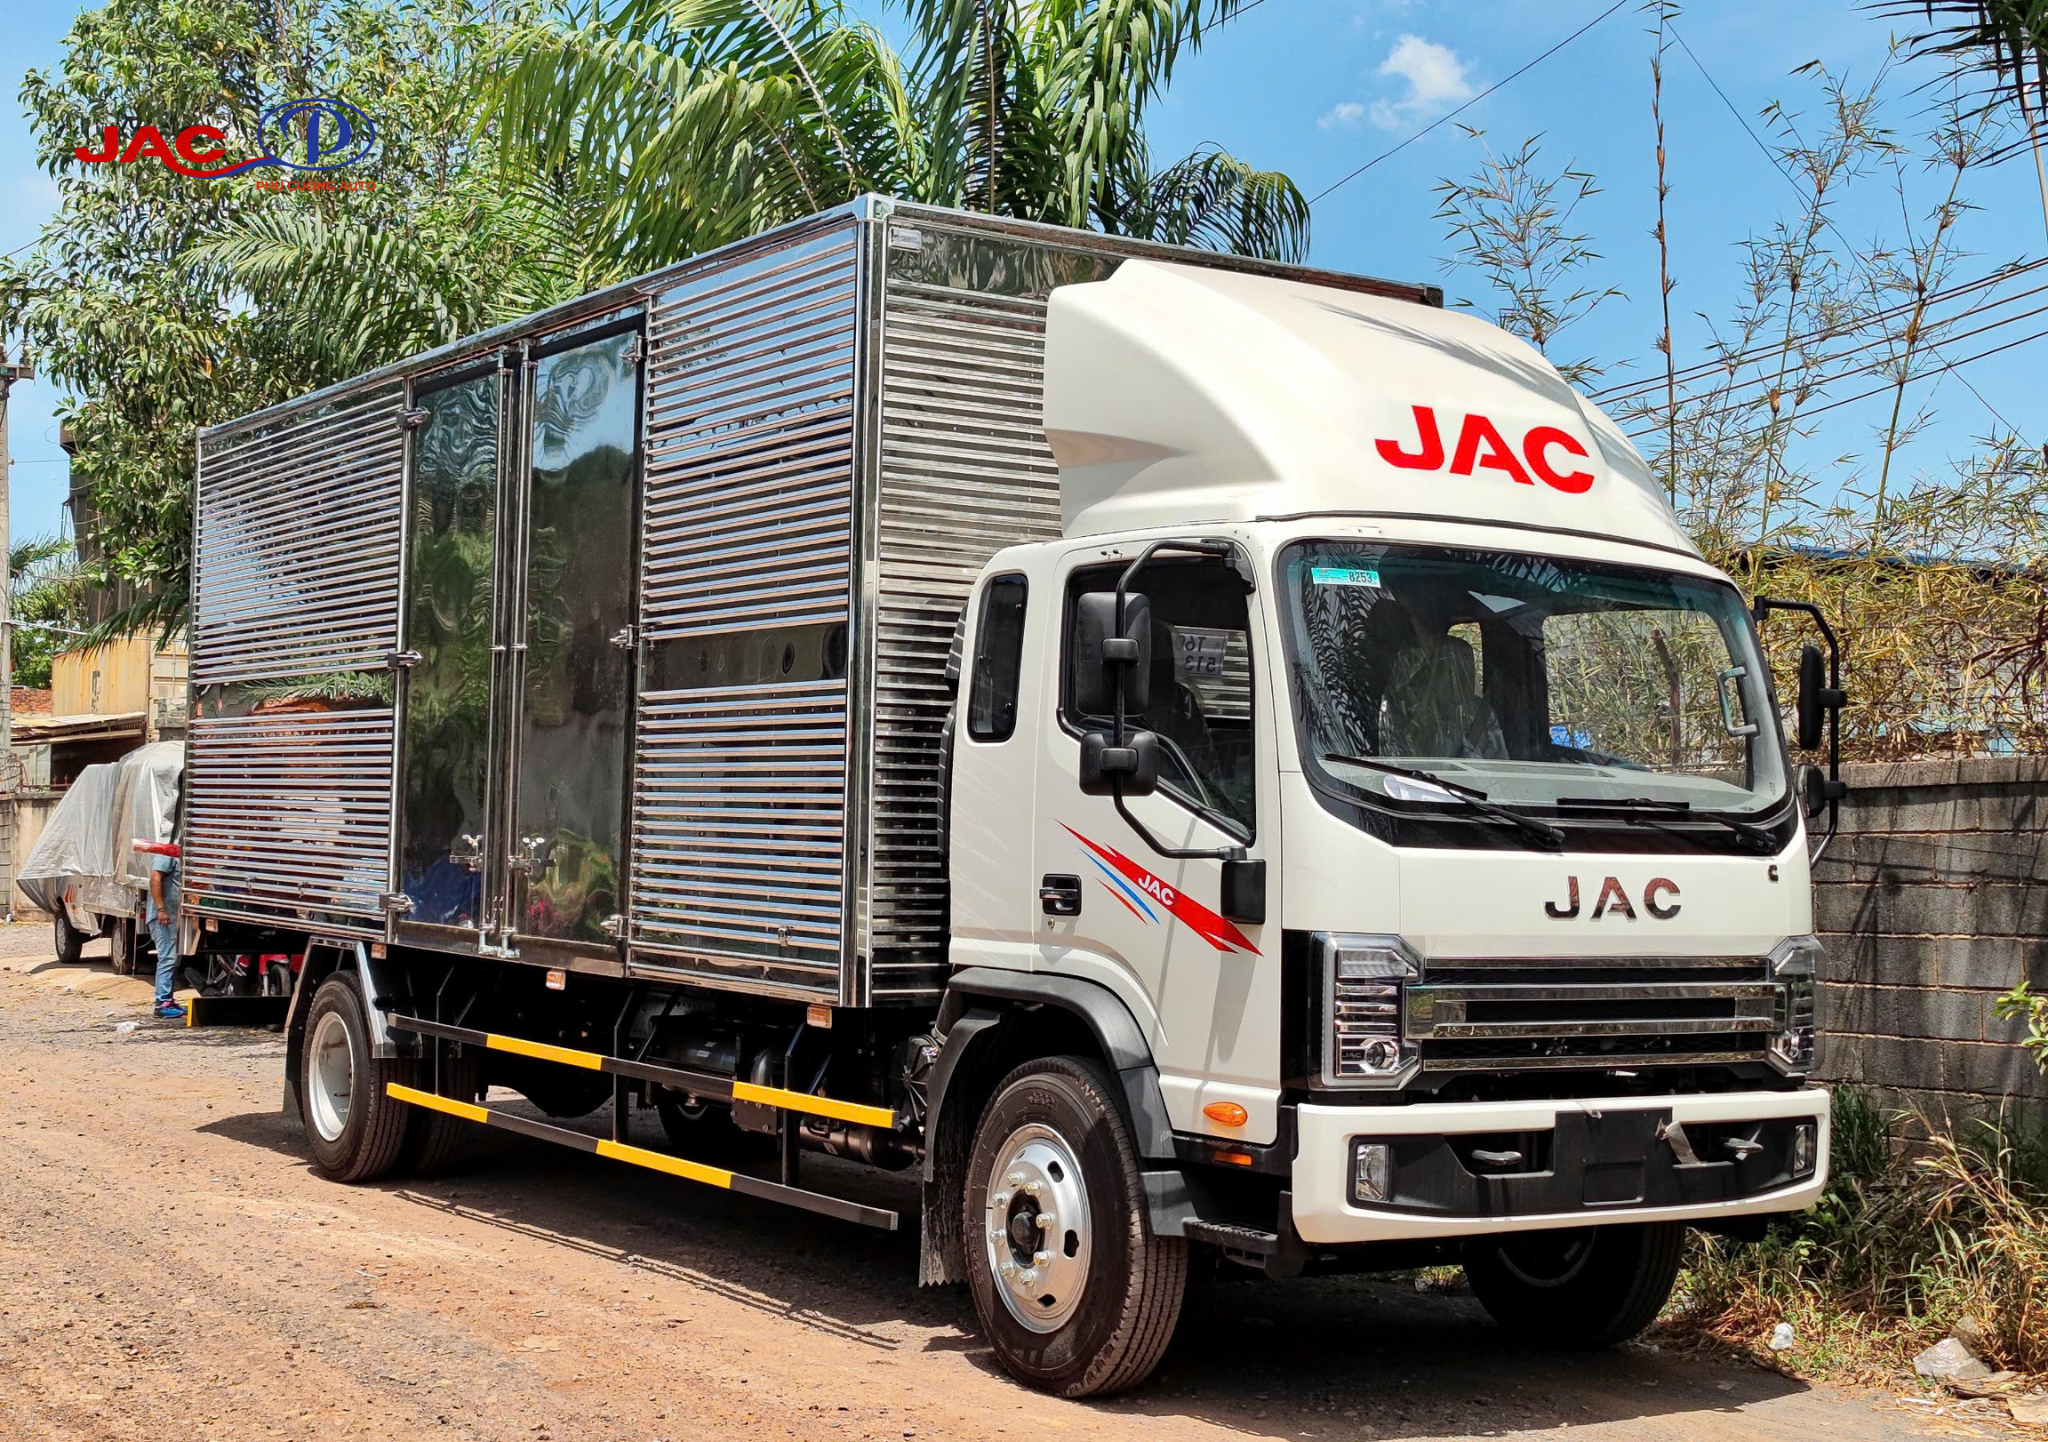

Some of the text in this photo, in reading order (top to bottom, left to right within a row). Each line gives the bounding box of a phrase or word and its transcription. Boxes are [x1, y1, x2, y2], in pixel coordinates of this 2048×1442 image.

[1374, 404, 1595, 494] JAC
[1348, 571, 1373, 583] 8253
[1137, 874, 1175, 906] JAC
[1544, 875, 1682, 923] JAC
